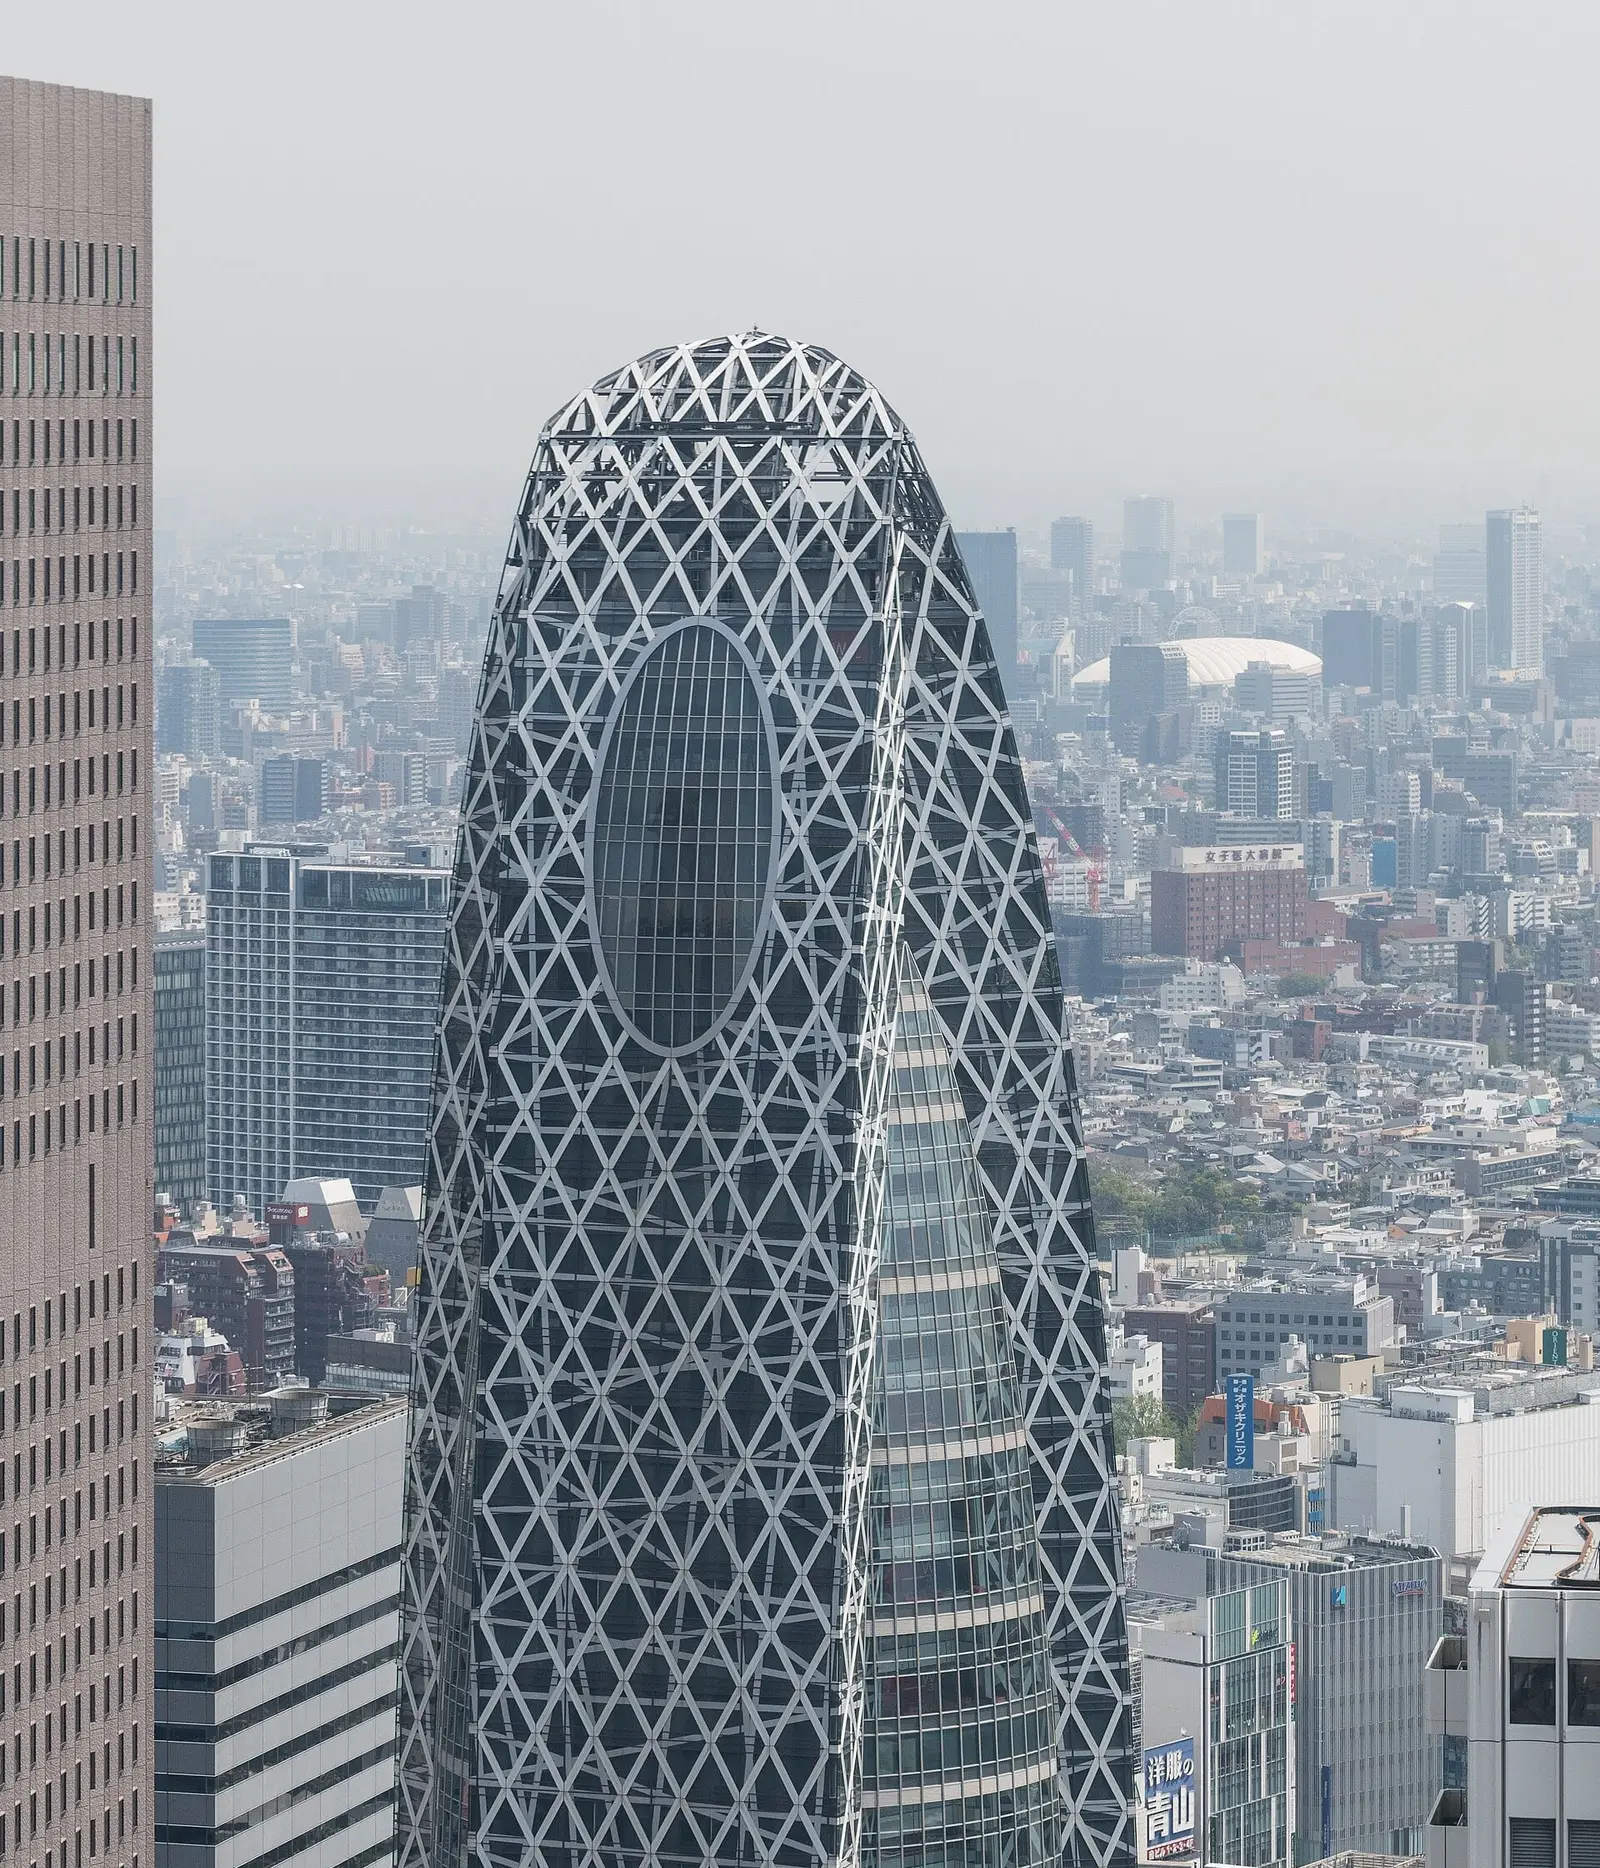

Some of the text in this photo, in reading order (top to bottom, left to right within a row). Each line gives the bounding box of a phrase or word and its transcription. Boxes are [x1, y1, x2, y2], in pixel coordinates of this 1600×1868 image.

[1234, 1393, 1247, 1466] オザキクリニック
[1148, 1749, 1194, 1787] 洋服の
[1147, 1785, 1195, 1841] 青山
